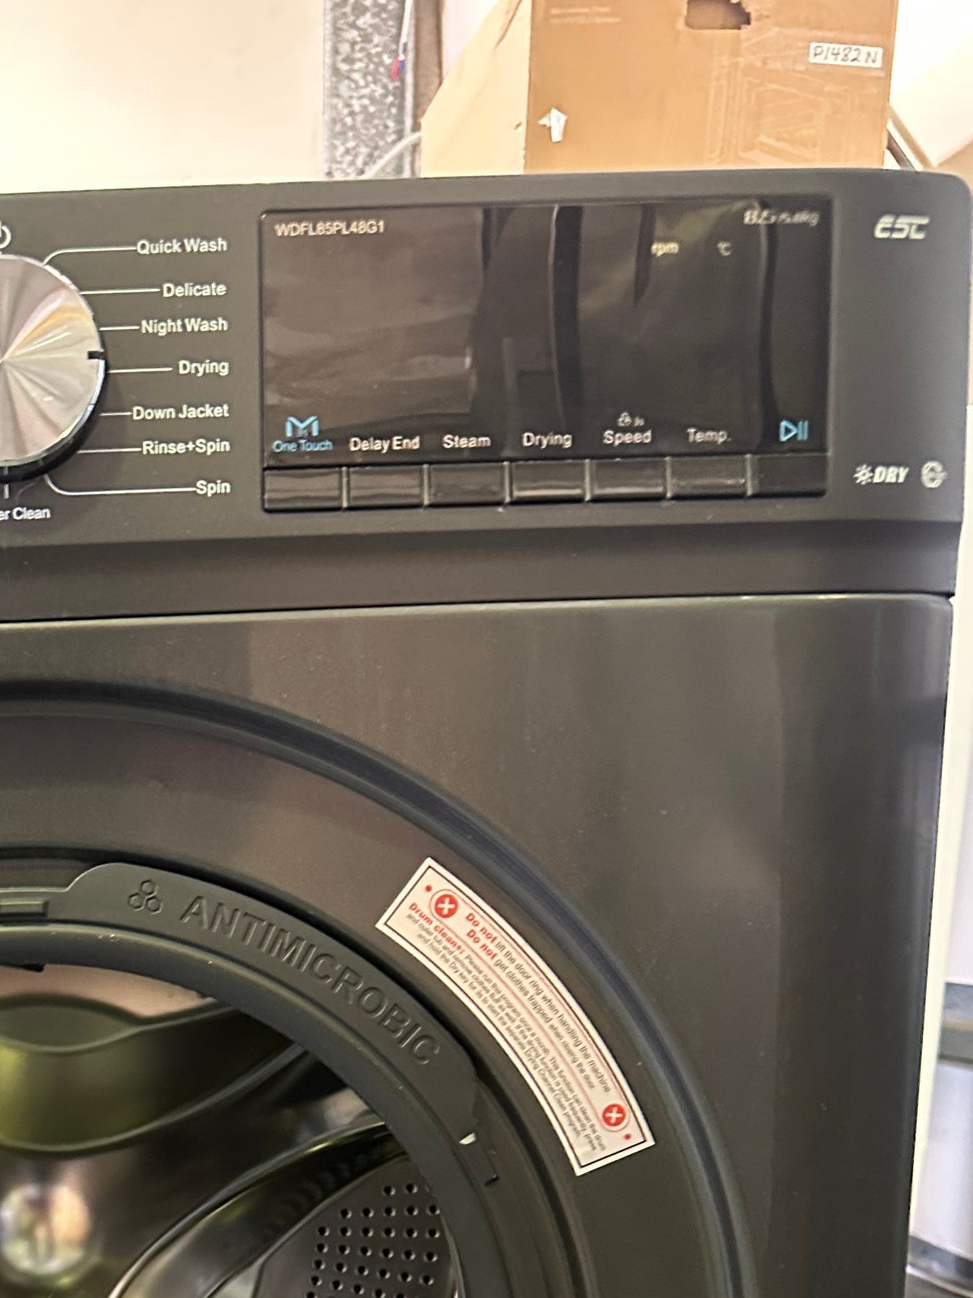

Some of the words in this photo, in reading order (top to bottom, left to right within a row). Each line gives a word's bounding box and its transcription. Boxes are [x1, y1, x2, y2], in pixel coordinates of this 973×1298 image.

[275, 220, 384, 237] WDFL85PL48G1
[137, 239, 182, 255] Quick
[184, 238, 227, 252] Wash
[163, 282, 227, 297] Delicate
[141, 319, 183, 336] Night
[185, 317, 229, 332] Wash
[178, 360, 229, 376] Drying
[132, 406, 176, 420] Down
[179, 404, 229, 419] Jacket
[272, 440, 299, 452] One
[299, 438, 333, 452] Touch
[349, 436, 389, 454] Delay
[392, 435, 421, 450] End
[442, 434, 491, 449] Steam
[522, 432, 573, 449] Drying
[602, 429, 652, 447] Speed
[142, 438, 230, 456] Rinse+Spin
[873, 466, 909, 483] DRY
[195, 480, 231, 497] Spin
[12, 507, 51, 520] Clean
[407, 901, 435, 926] Drum
[465, 928, 482, 945] Do
[479, 941, 498, 961] not
[492, 956, 509, 974] get
[179, 894, 442, 1067] ANTIMICROBIC
[464, 911, 482, 928] Do
[478, 924, 499, 945] not
[502, 949, 518, 964] the
[513, 960, 533, 981] door
[526, 977, 545, 997] ring
[540, 992, 561, 1016] when
[555, 1011, 585, 1048] handling
[578, 1044, 594, 1061] the
